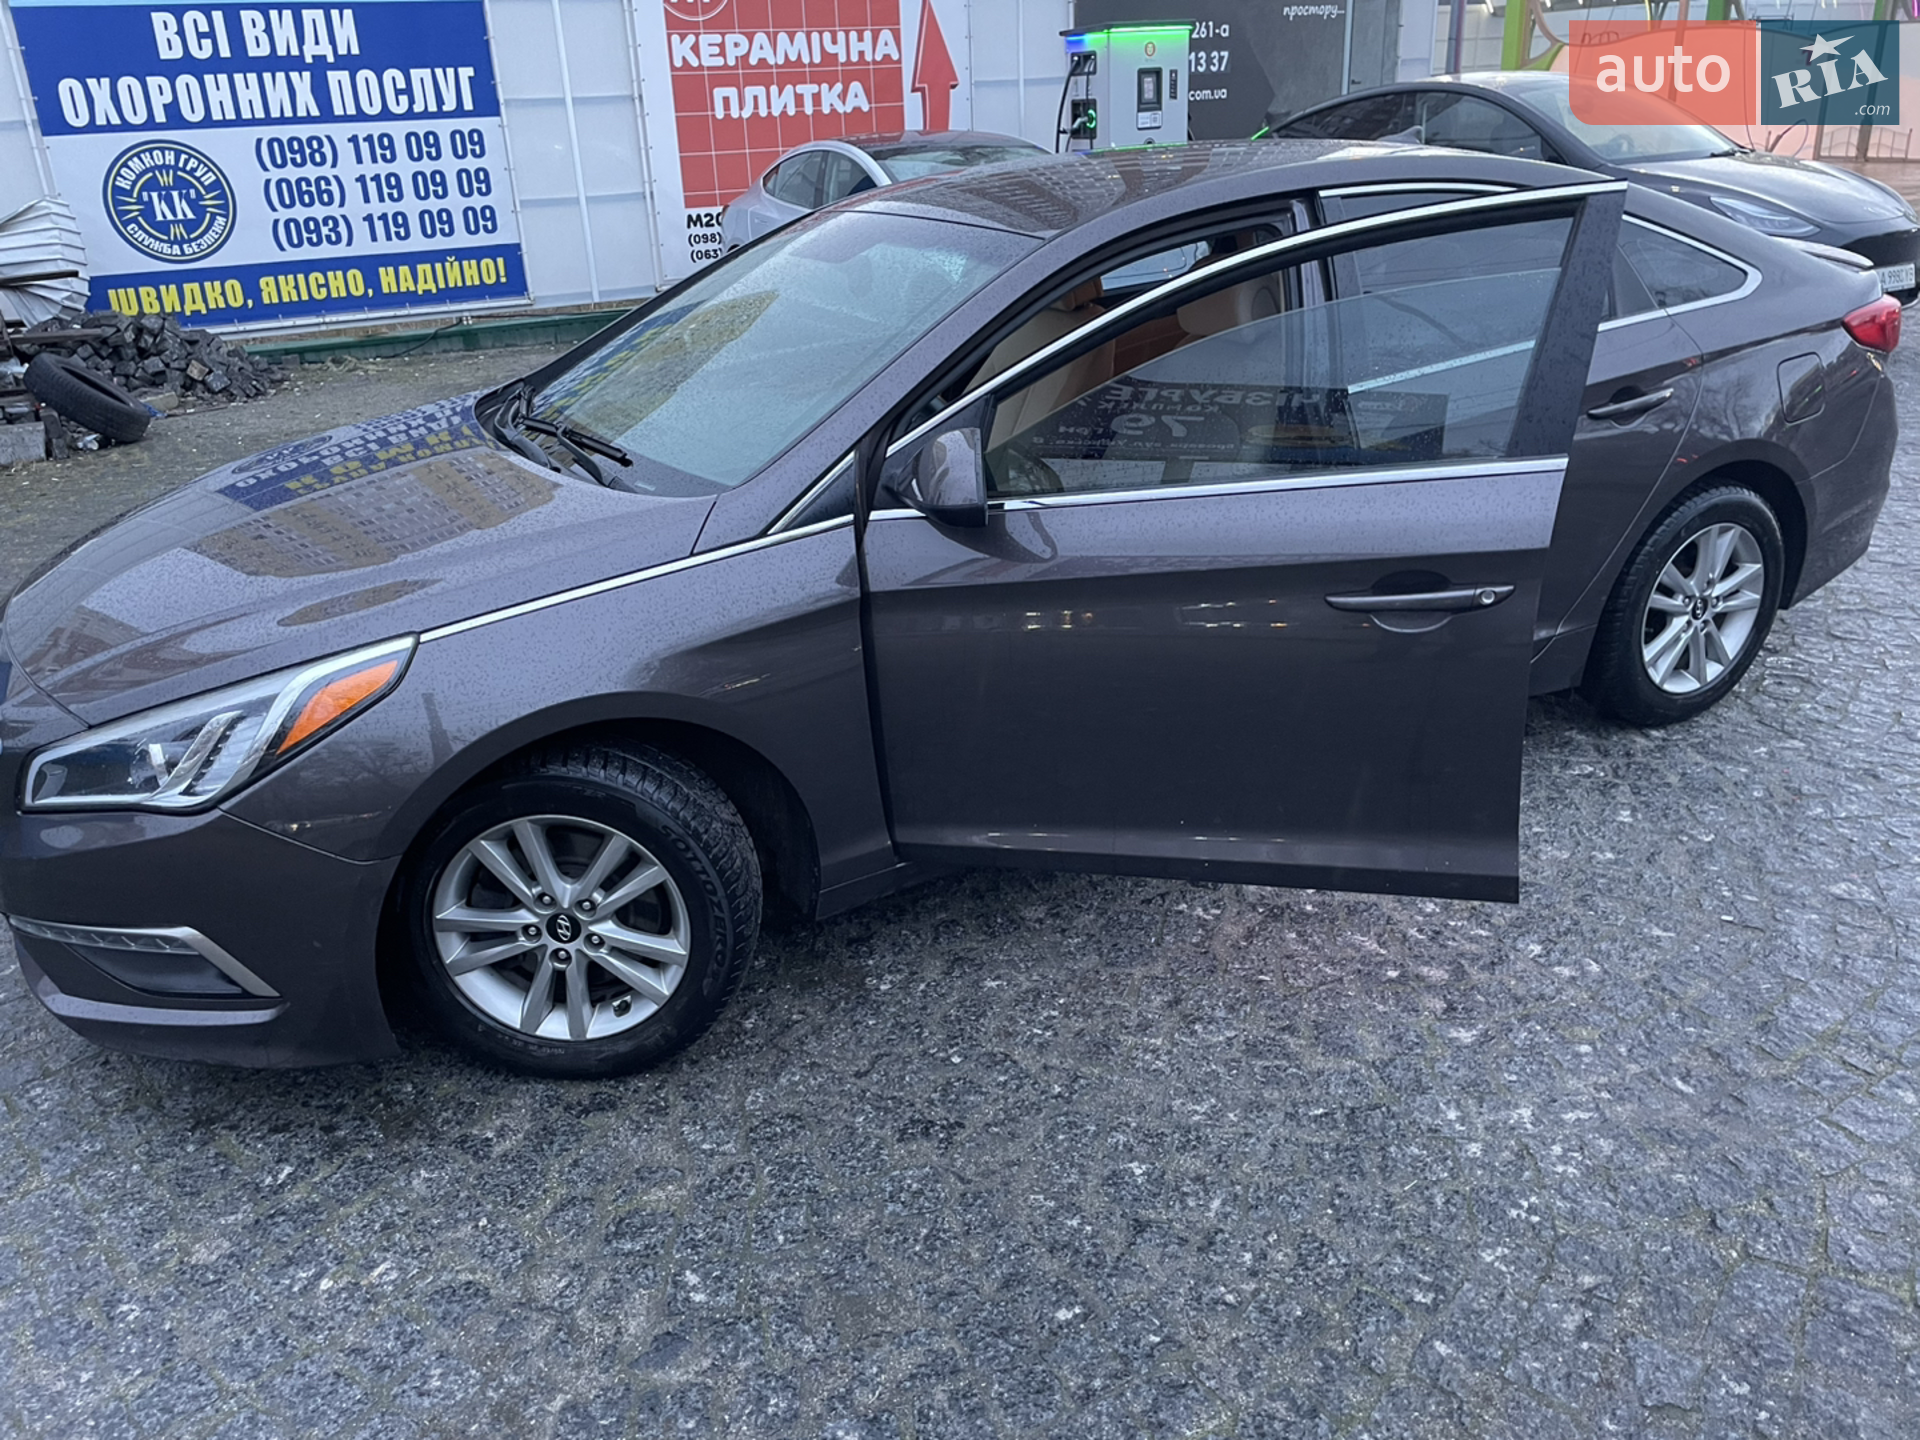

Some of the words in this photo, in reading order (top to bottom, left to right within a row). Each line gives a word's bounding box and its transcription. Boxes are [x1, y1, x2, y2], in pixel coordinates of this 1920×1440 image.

[151, 10, 232, 60] ВСІ
[239, 9, 360, 64] ВИДИ
[670, 29, 899, 68] КЕРАМІЧНА
[1210, 50, 1229, 72] 37
[57, 71, 320, 127] ОХОРОННИХ
[326, 66, 475, 117] ПОСЛУГ
[713, 81, 870, 120] ПЛИТКА
[115, 149, 175, 190] КОМКОН
[178, 153, 217, 186] ГРУП
[255, 134, 339, 172] (098)
[347, 132, 398, 164] 119
[404, 130, 443, 162] 09
[449, 128, 487, 160] 09
[263, 174, 347, 212] (066)
[355, 171, 405, 204] 119
[411, 169, 449, 201] 09
[456, 167, 493, 198] 09
[126, 223, 182, 255] СЛУЖБА
[182, 215, 227, 255] БЕЗПЕКИ
[272, 214, 355, 251] (093)
[362, 211, 412, 242] 119
[418, 208, 456, 239] 09
[462, 205, 499, 235] 09
[688, 231, 722, 247] (098)
[107, 278, 253, 316] ШВИДКО,
[259, 268, 373, 304] ЯКІСНО,
[378, 256, 507, 295] НАДІЙНО!
